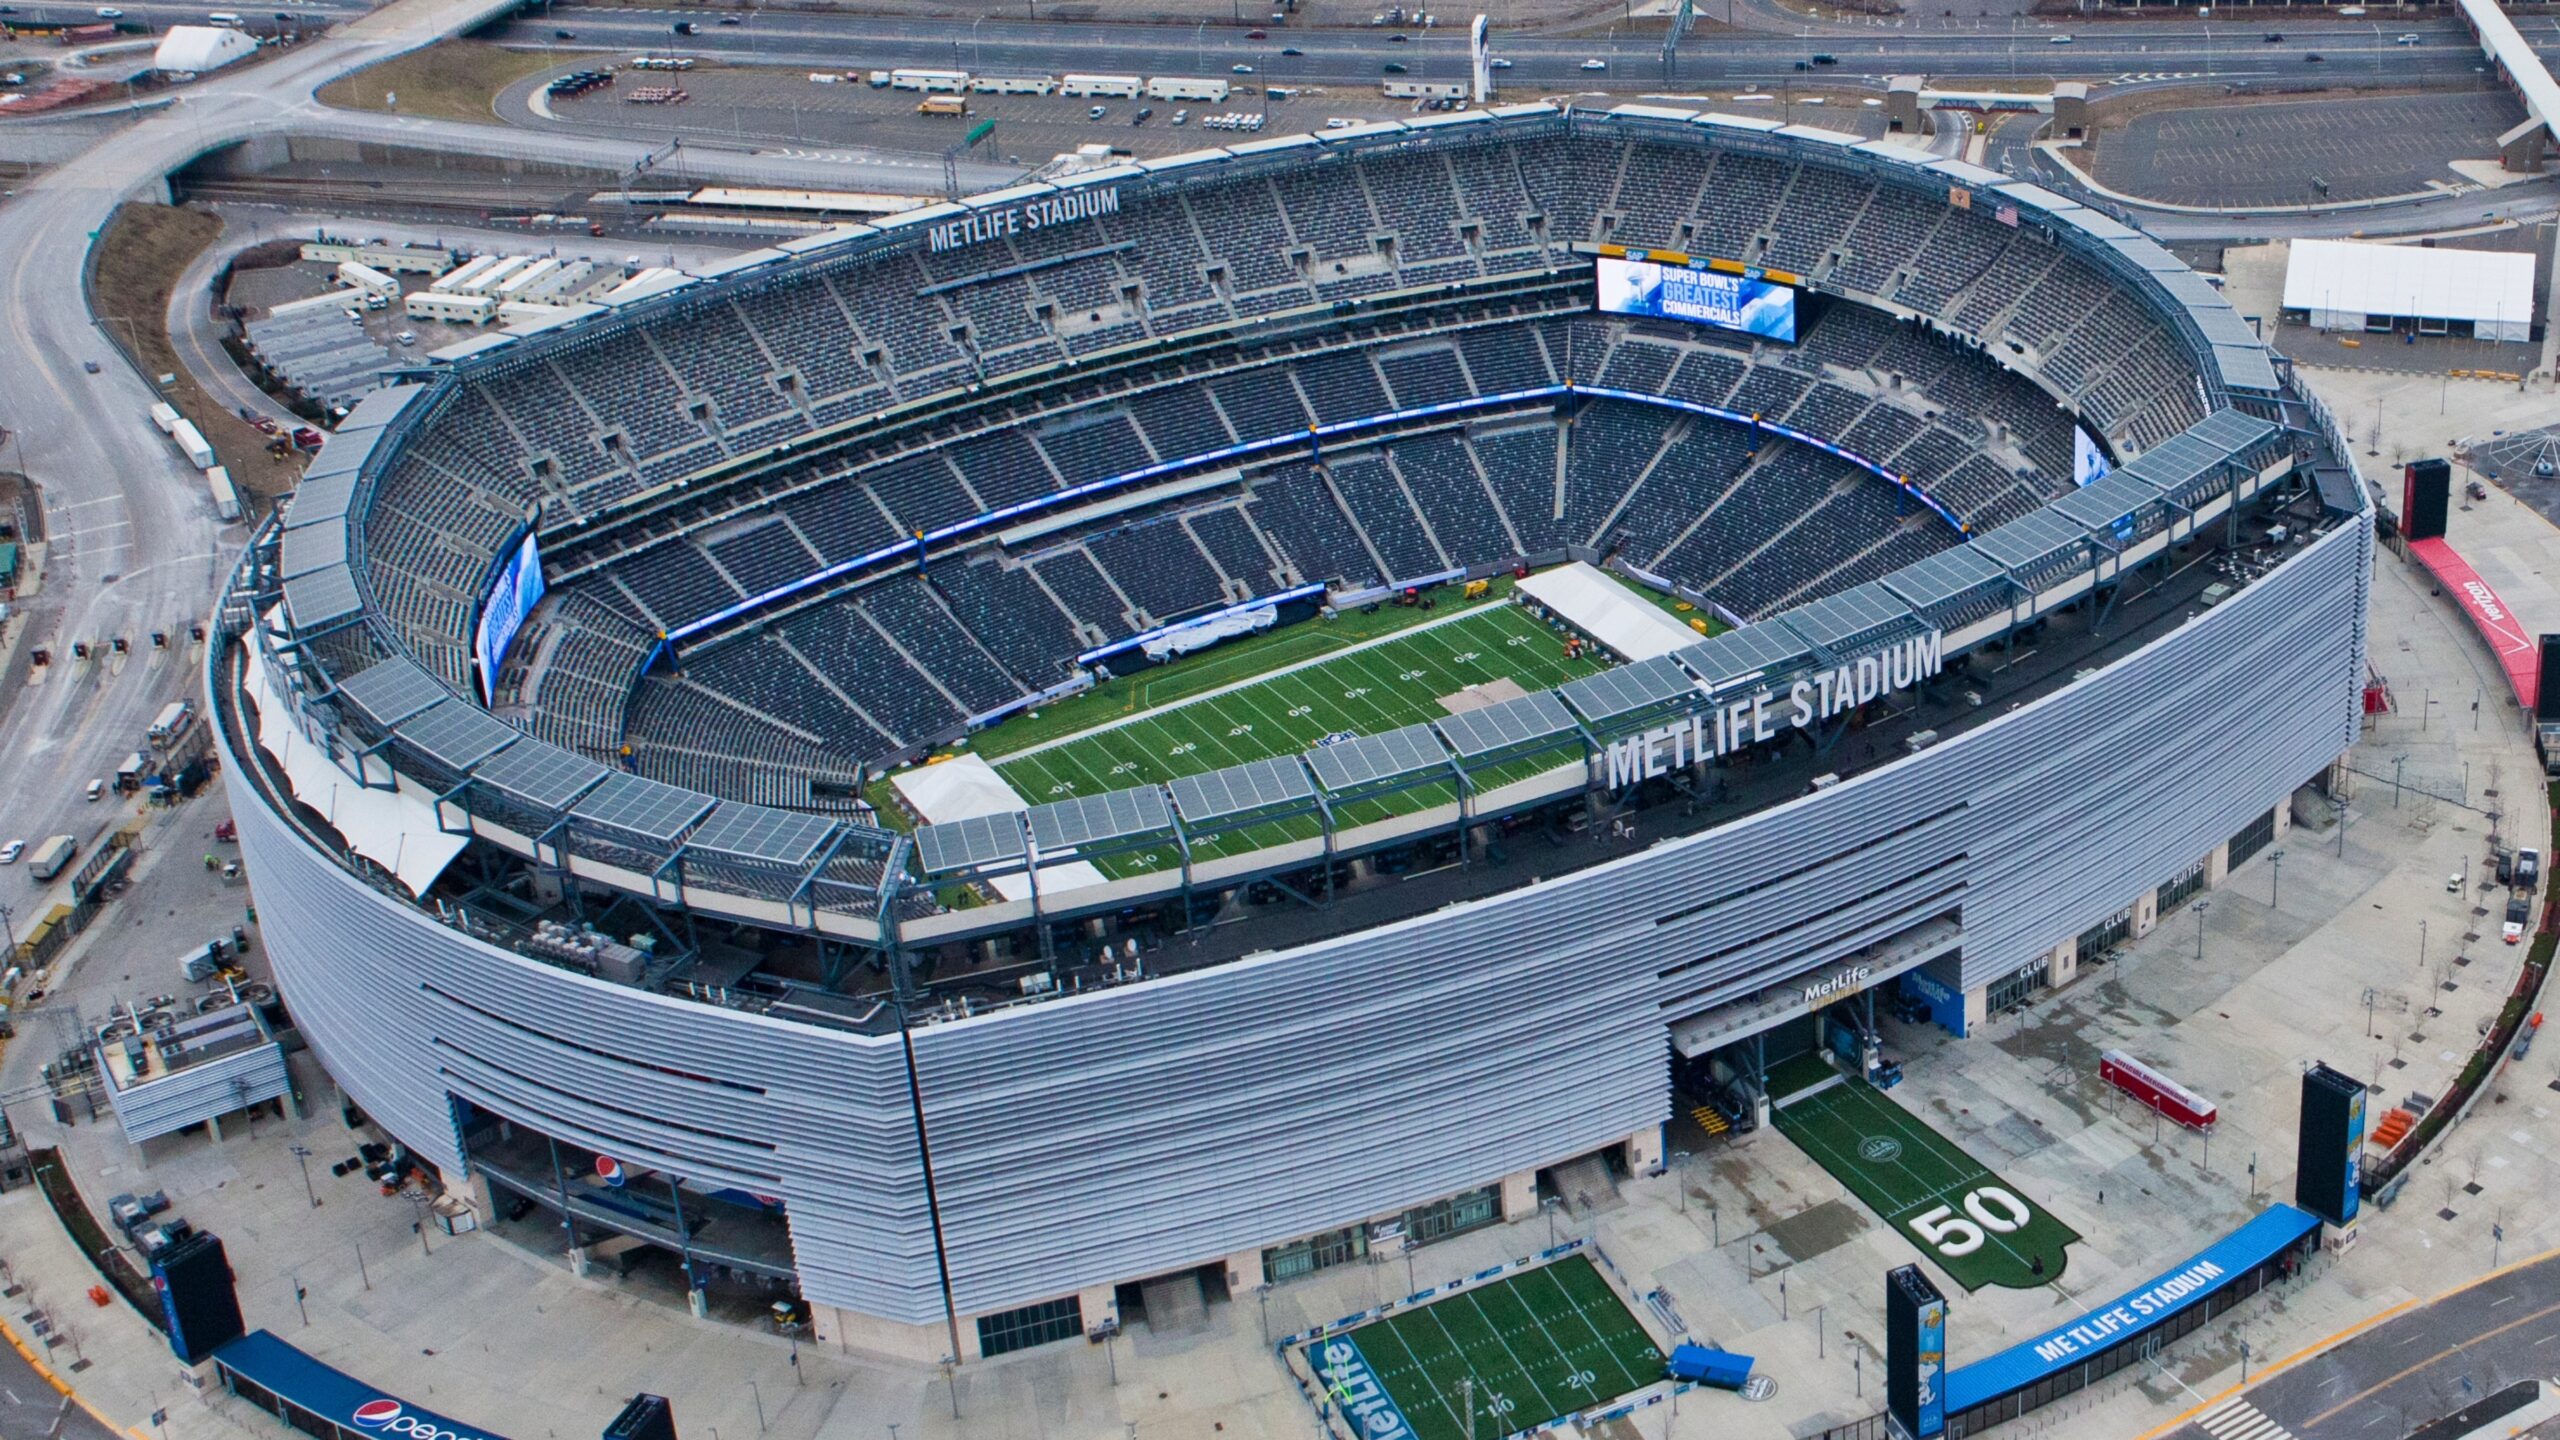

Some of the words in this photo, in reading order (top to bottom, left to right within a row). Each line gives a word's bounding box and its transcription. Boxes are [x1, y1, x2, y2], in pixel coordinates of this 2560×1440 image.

[929, 208, 1020, 253] METLIFE
[1026, 187, 1120, 230] STADIUM
[1626, 250, 1644, 261] SAP
[1688, 258, 1706, 270] SAP
[1662, 267, 1698, 284] SUPER
[1699, 272, 1740, 293] BOWL'S
[1744, 268, 1761, 279] SAP
[1663, 282, 1739, 309] GREATEST
[1662, 300, 1741, 324] COMMERCIALS
[2463, 581, 2505, 621] verizon
[1607, 691, 1776, 790] METLIFE
[1790, 628, 1942, 729] STADIUM
[2172, 859, 2204, 889] SUITES
[2104, 907, 2132, 931] CLUB
[2019, 955, 2049, 979] CLUB
[1804, 966, 1870, 1002] MetLife
[1908, 1186, 2031, 1257] 50
[2033, 1306, 2139, 1362] METLIFE
[2129, 1260, 2225, 1316] STADIUM
[1566, 1369, 1596, 1390] 20
